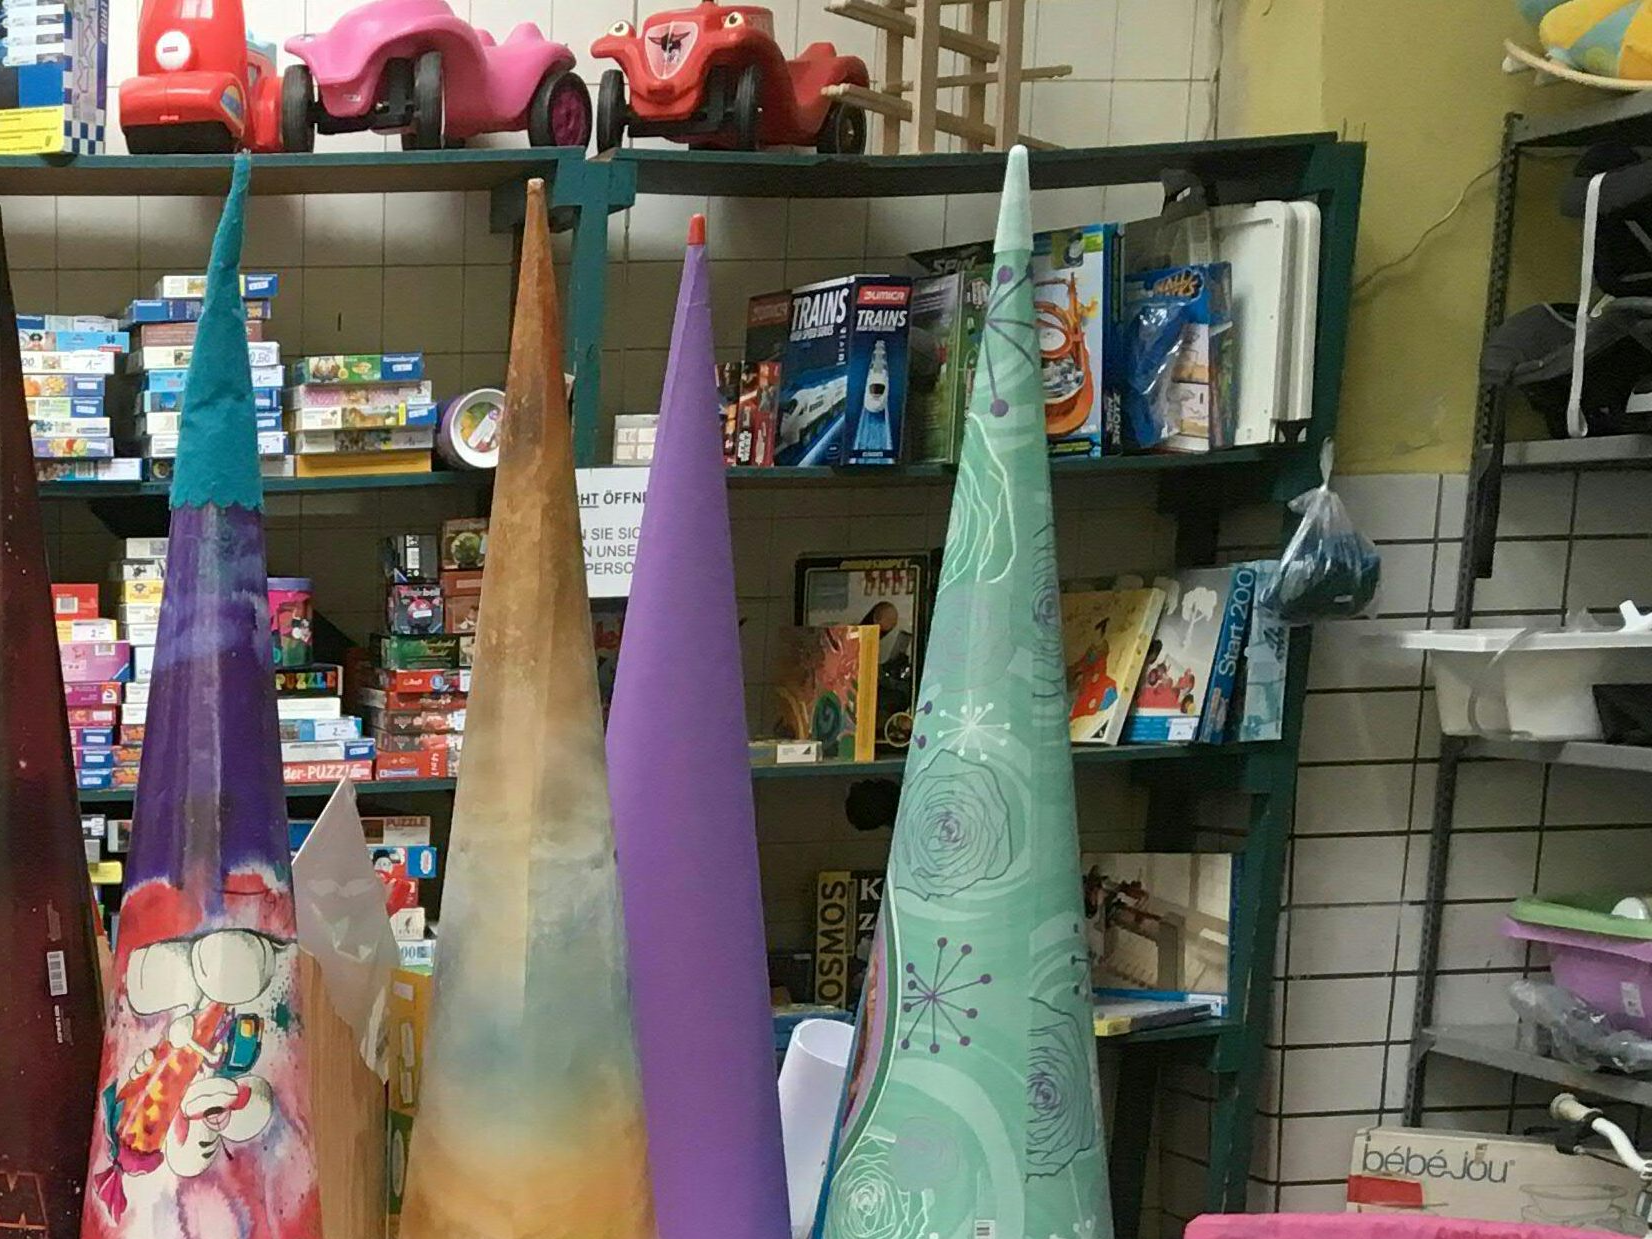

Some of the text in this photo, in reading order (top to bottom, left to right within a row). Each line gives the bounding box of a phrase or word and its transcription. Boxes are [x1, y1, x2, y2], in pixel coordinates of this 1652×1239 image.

[792, 287, 849, 333] TRAINS
[857, 309, 908, 327] TRAINS
[591, 527, 614, 541] SIE
[1219, 622, 1245, 677] Start
[275, 671, 338, 691] PUZZLE
[817, 880, 848, 1007] OSMOS
